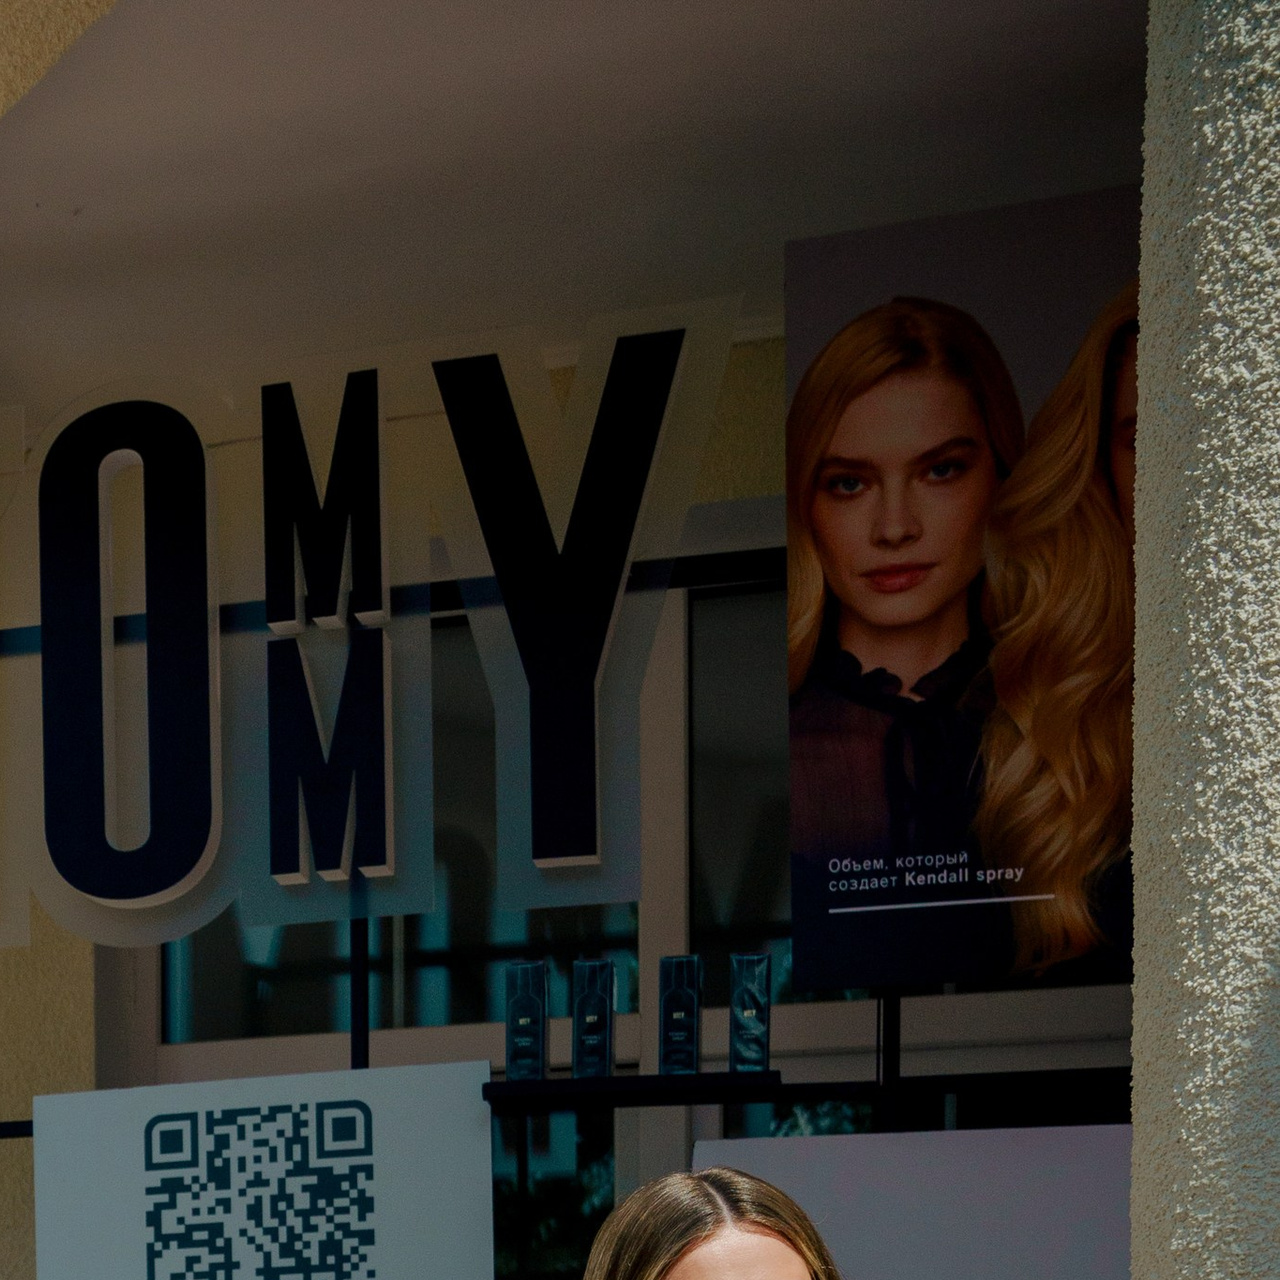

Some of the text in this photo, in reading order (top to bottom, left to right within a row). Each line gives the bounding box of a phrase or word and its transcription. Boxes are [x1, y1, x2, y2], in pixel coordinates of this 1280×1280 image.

[896, 851, 969, 869] который
[829, 867, 1025, 892] создает Kendall spray
